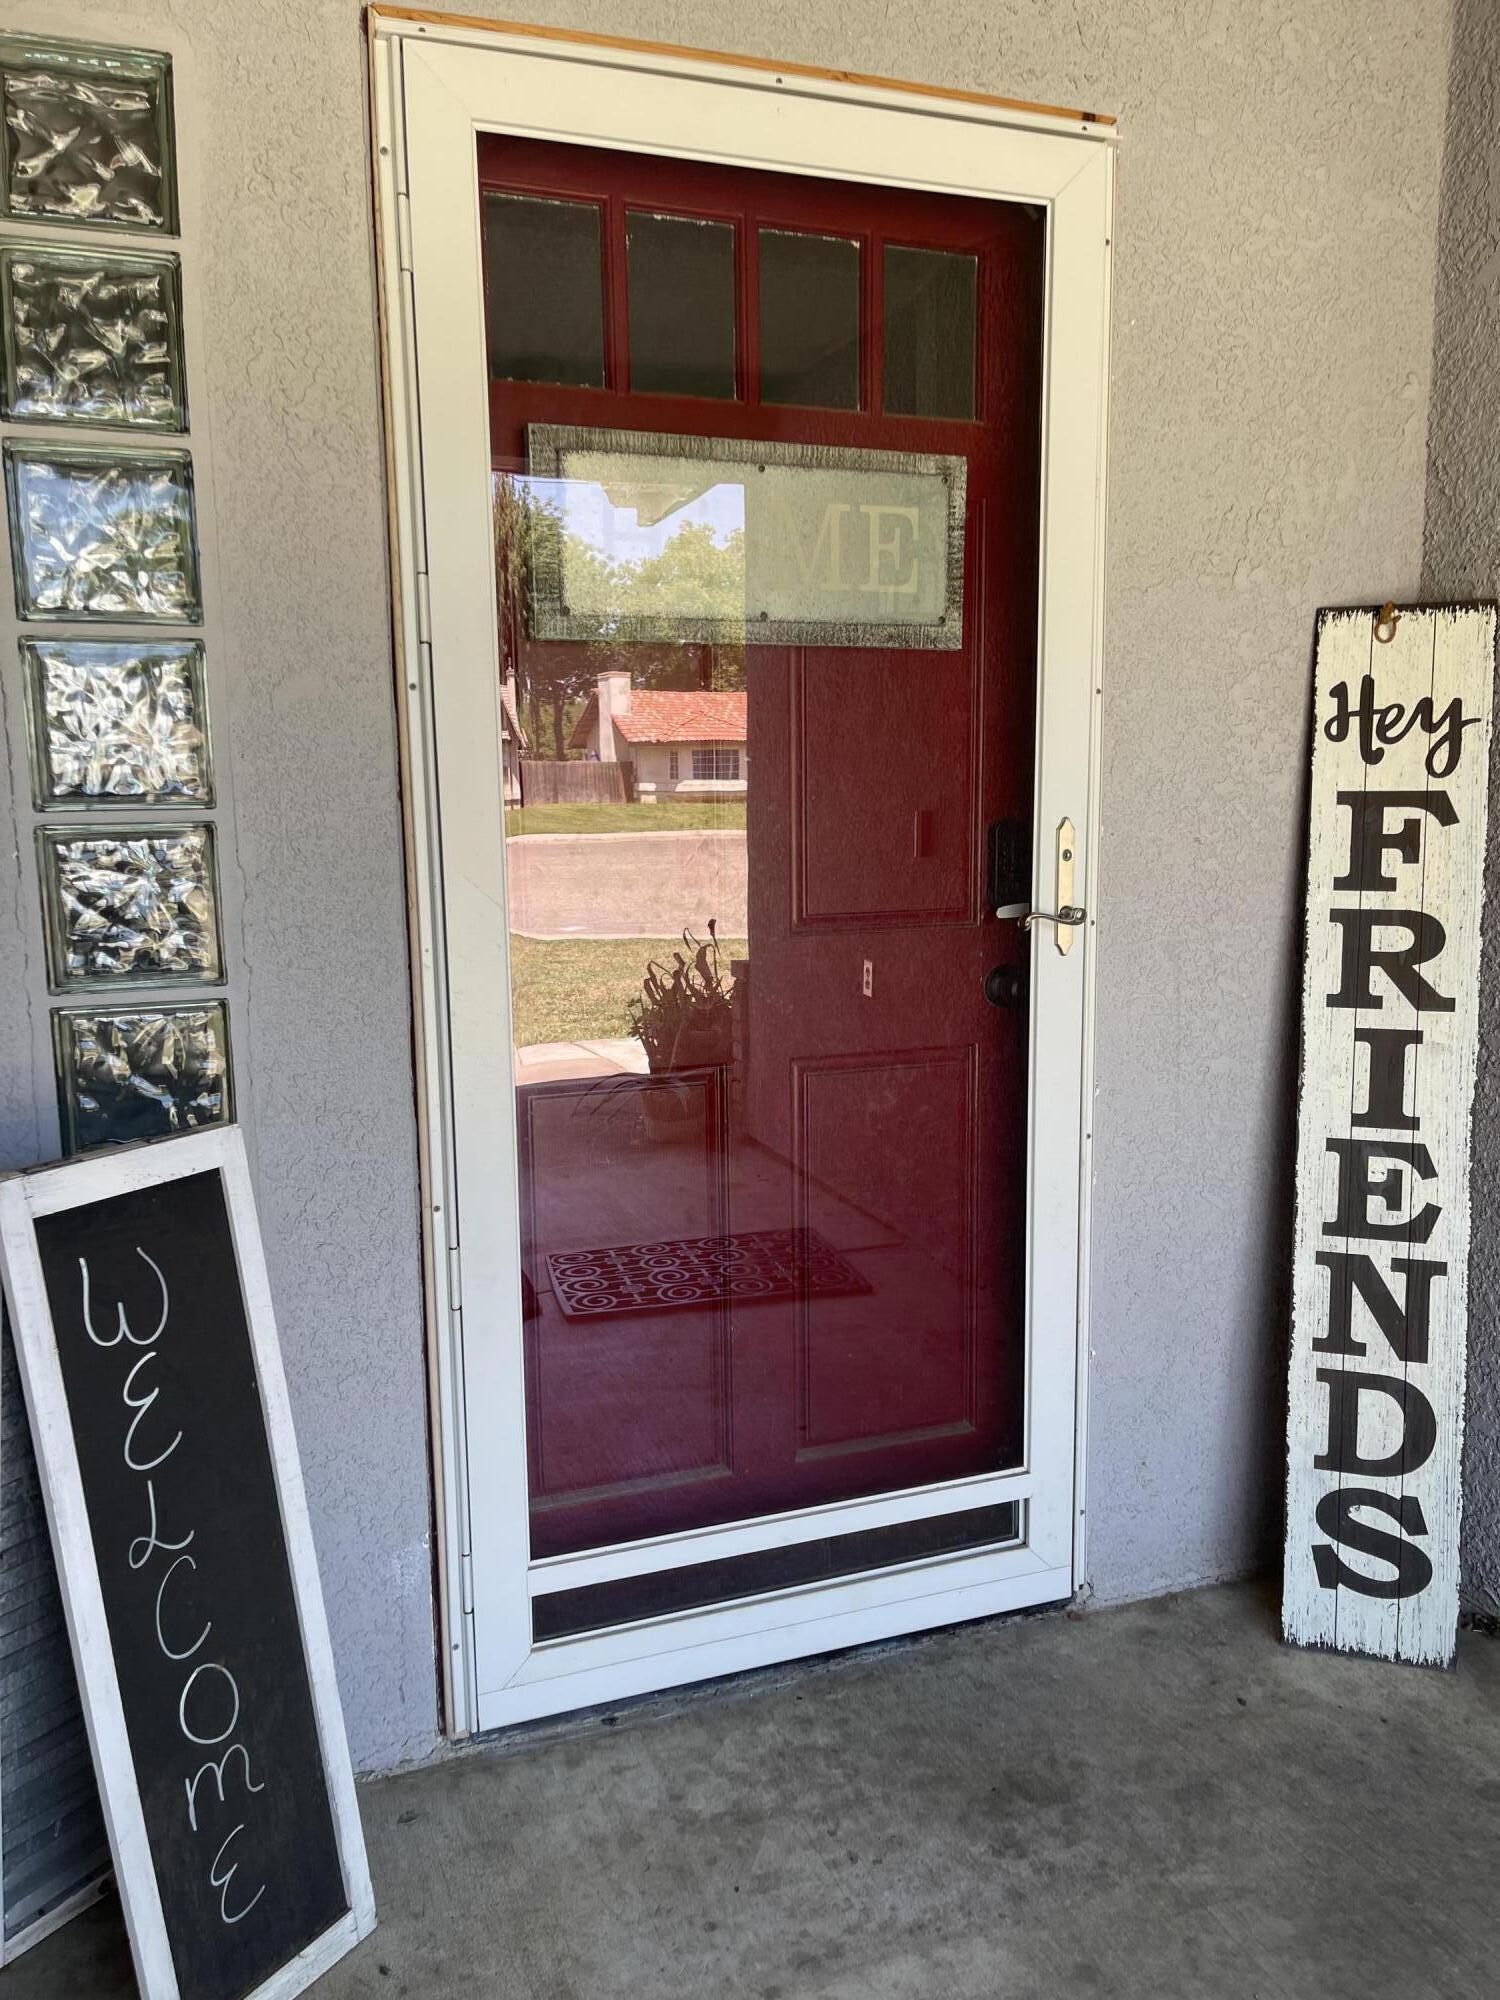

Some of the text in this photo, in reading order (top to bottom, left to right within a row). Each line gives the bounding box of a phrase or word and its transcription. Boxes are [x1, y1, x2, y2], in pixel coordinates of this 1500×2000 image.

[1324, 674, 1481, 778] Hey
[1311, 790, 1460, 1600] FRIENDS
[78, 1247, 265, 1924] WELCOME
